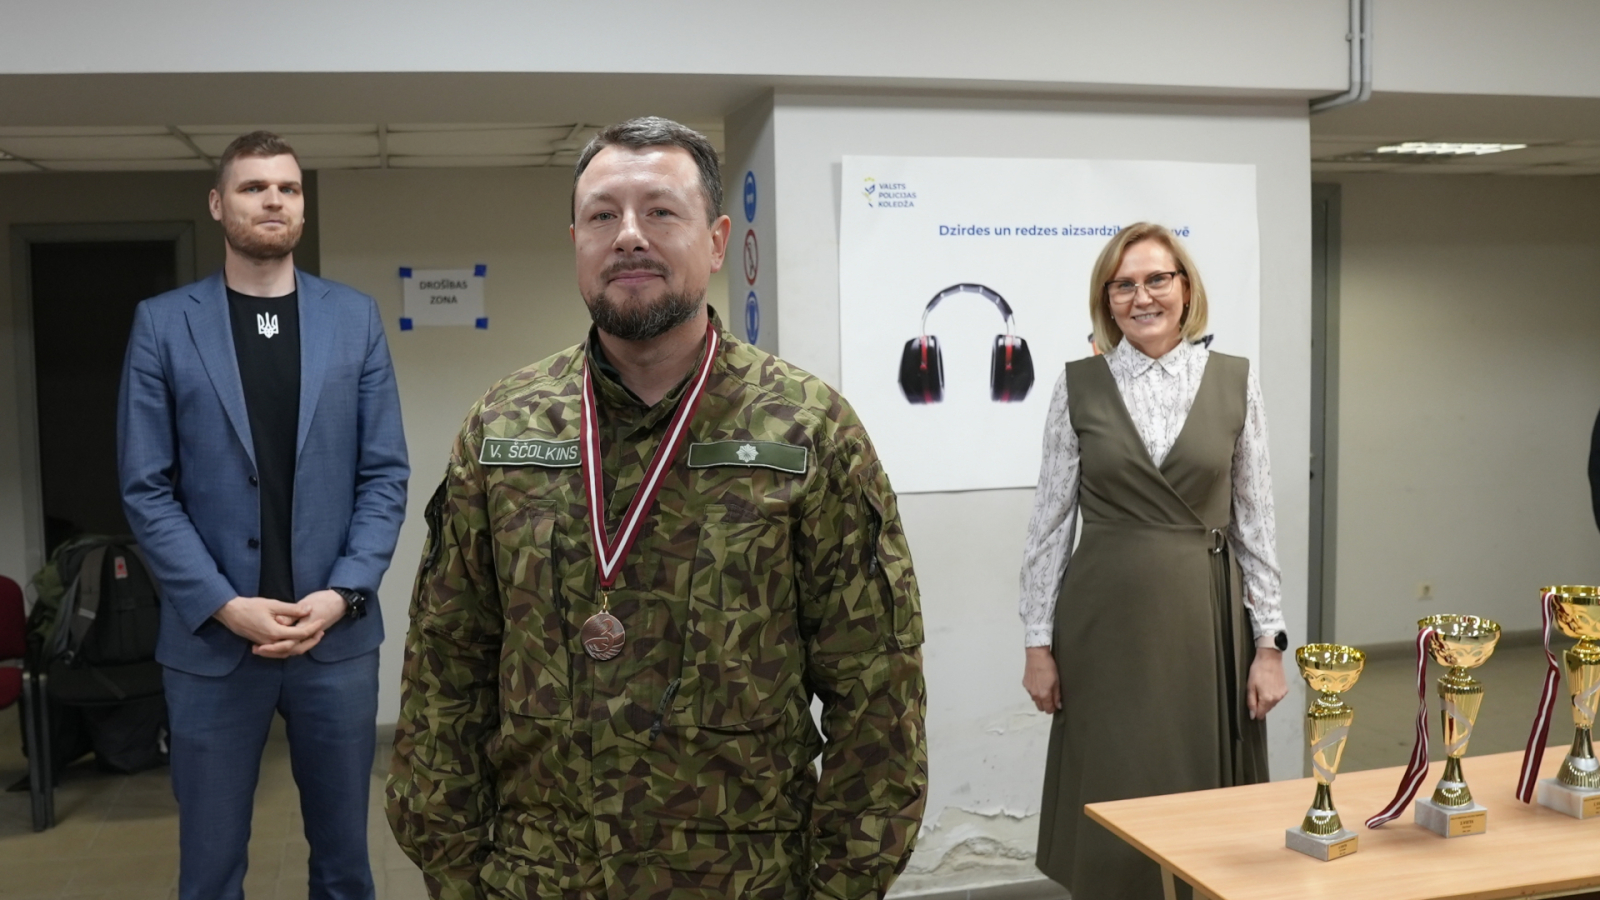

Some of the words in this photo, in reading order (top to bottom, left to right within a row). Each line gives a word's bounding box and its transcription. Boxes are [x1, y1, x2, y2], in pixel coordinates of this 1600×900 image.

[878, 200, 915, 208] KOLEDŽA
[939, 224, 990, 236] Dzirdes
[994, 227, 1011, 236] un
[1015, 224, 1058, 236] redzes
[430, 295, 458, 305] ZONA
[508, 441, 578, 461] ŠČOLKINS
